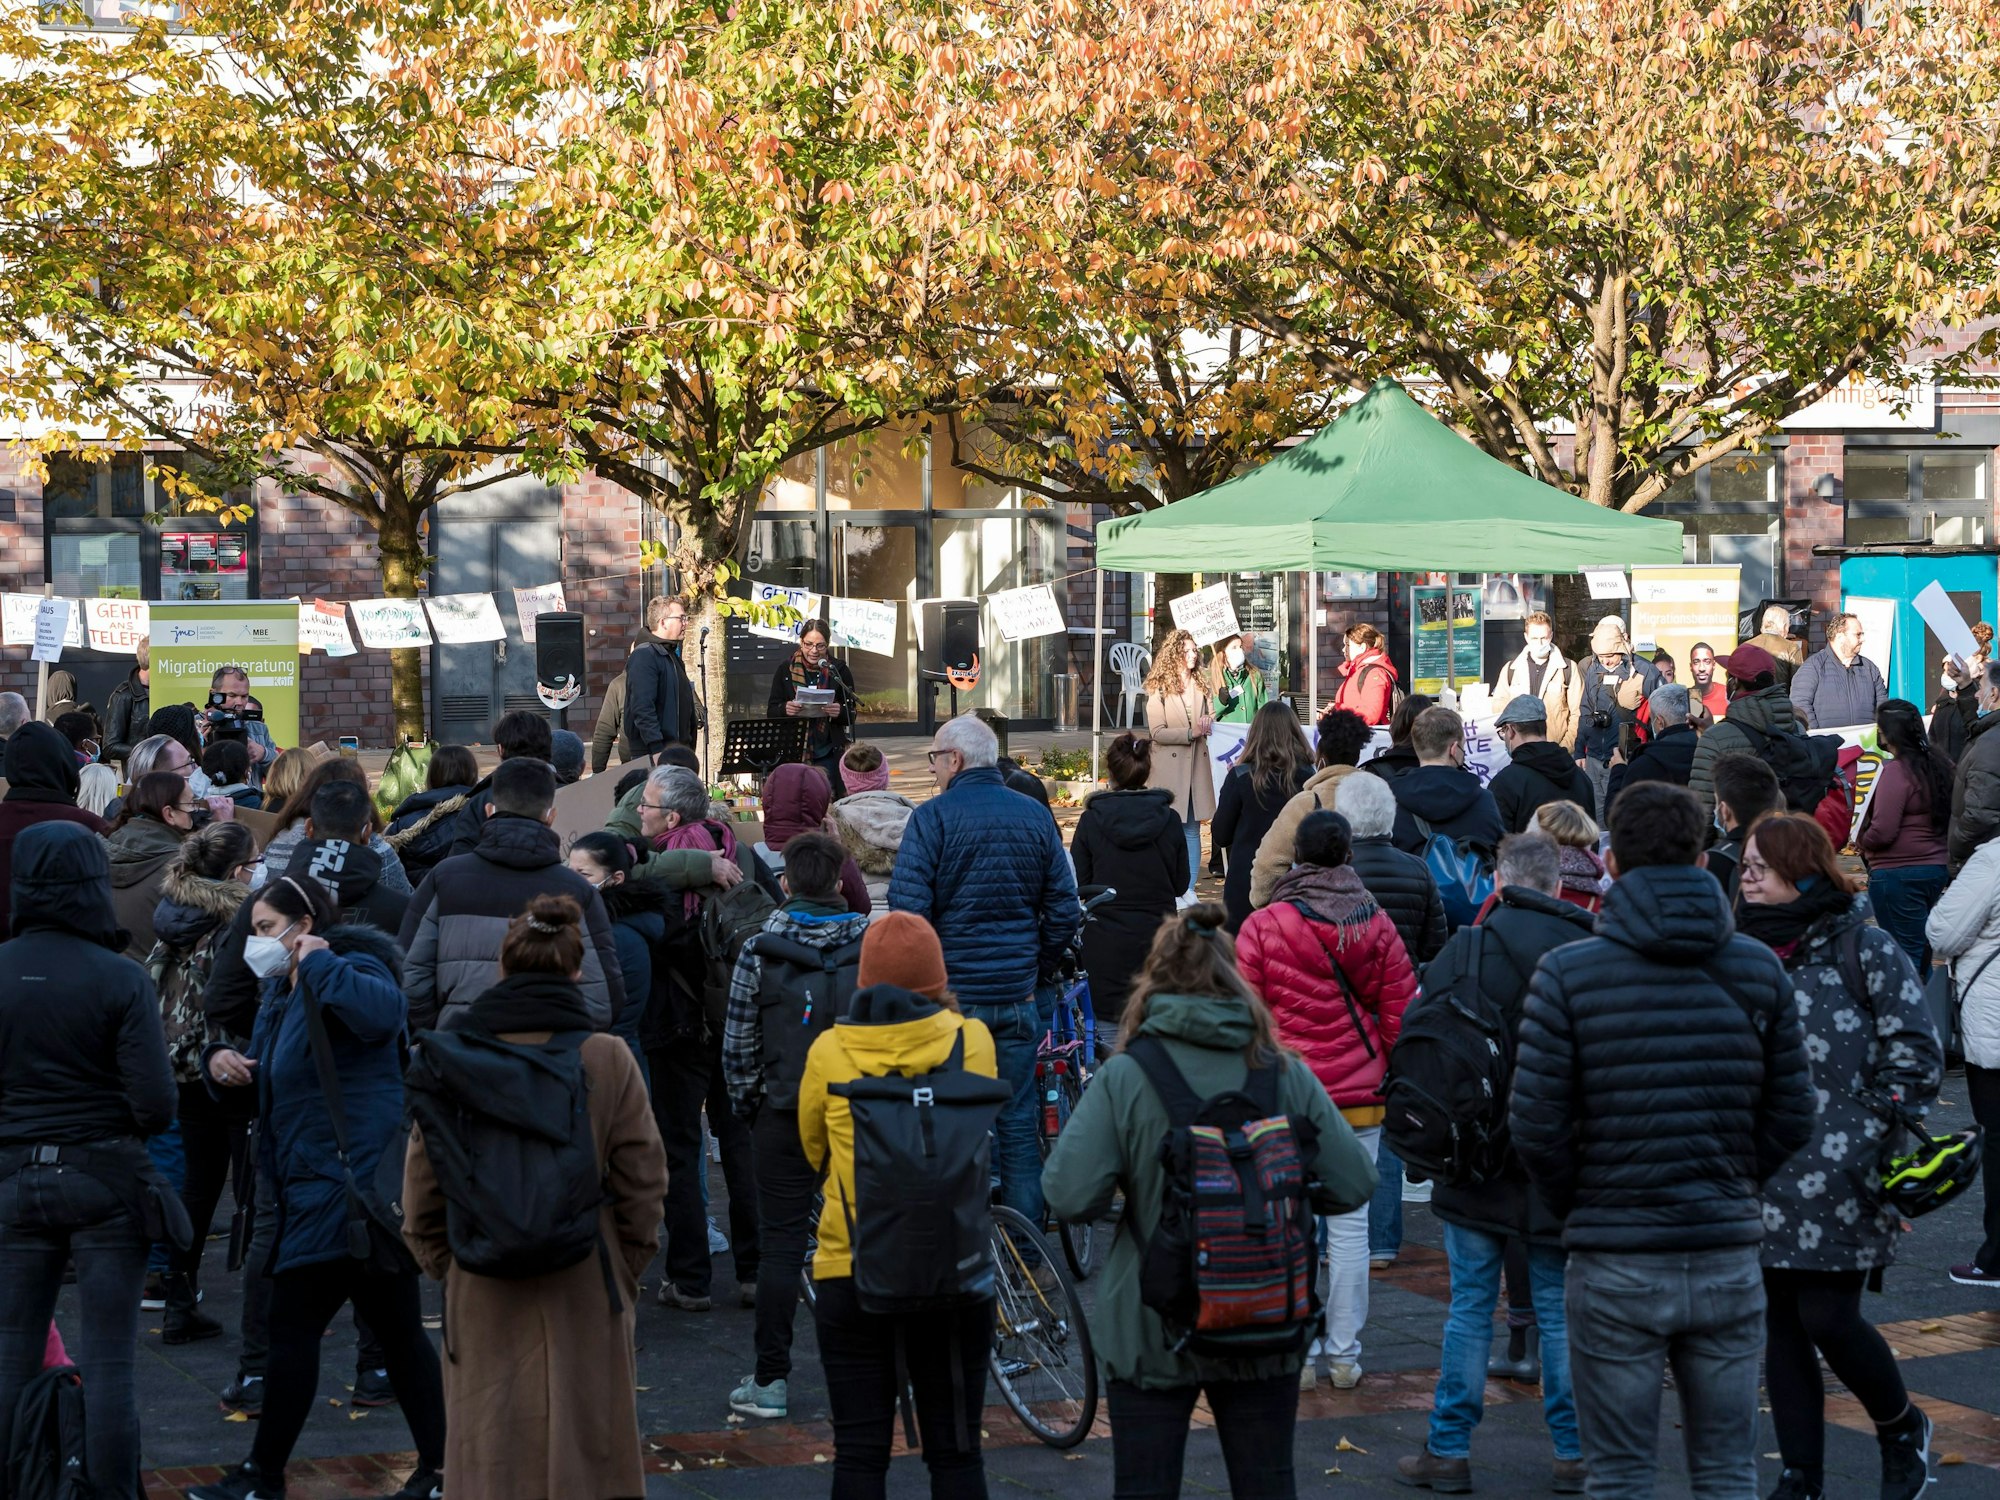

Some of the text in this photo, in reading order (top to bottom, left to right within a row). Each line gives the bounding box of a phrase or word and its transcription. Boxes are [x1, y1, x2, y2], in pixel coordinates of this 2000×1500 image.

[97, 603, 143, 620] GEHT
[1177, 594, 1203, 613] KEINE
[1179, 595, 1231, 625] GRUNDRECHTE
[1205, 608, 1225, 624] OHNE
[109, 622, 133, 631] ANS
[89, 629, 147, 646] TELEFO
[273, 676, 293, 686] Köln
